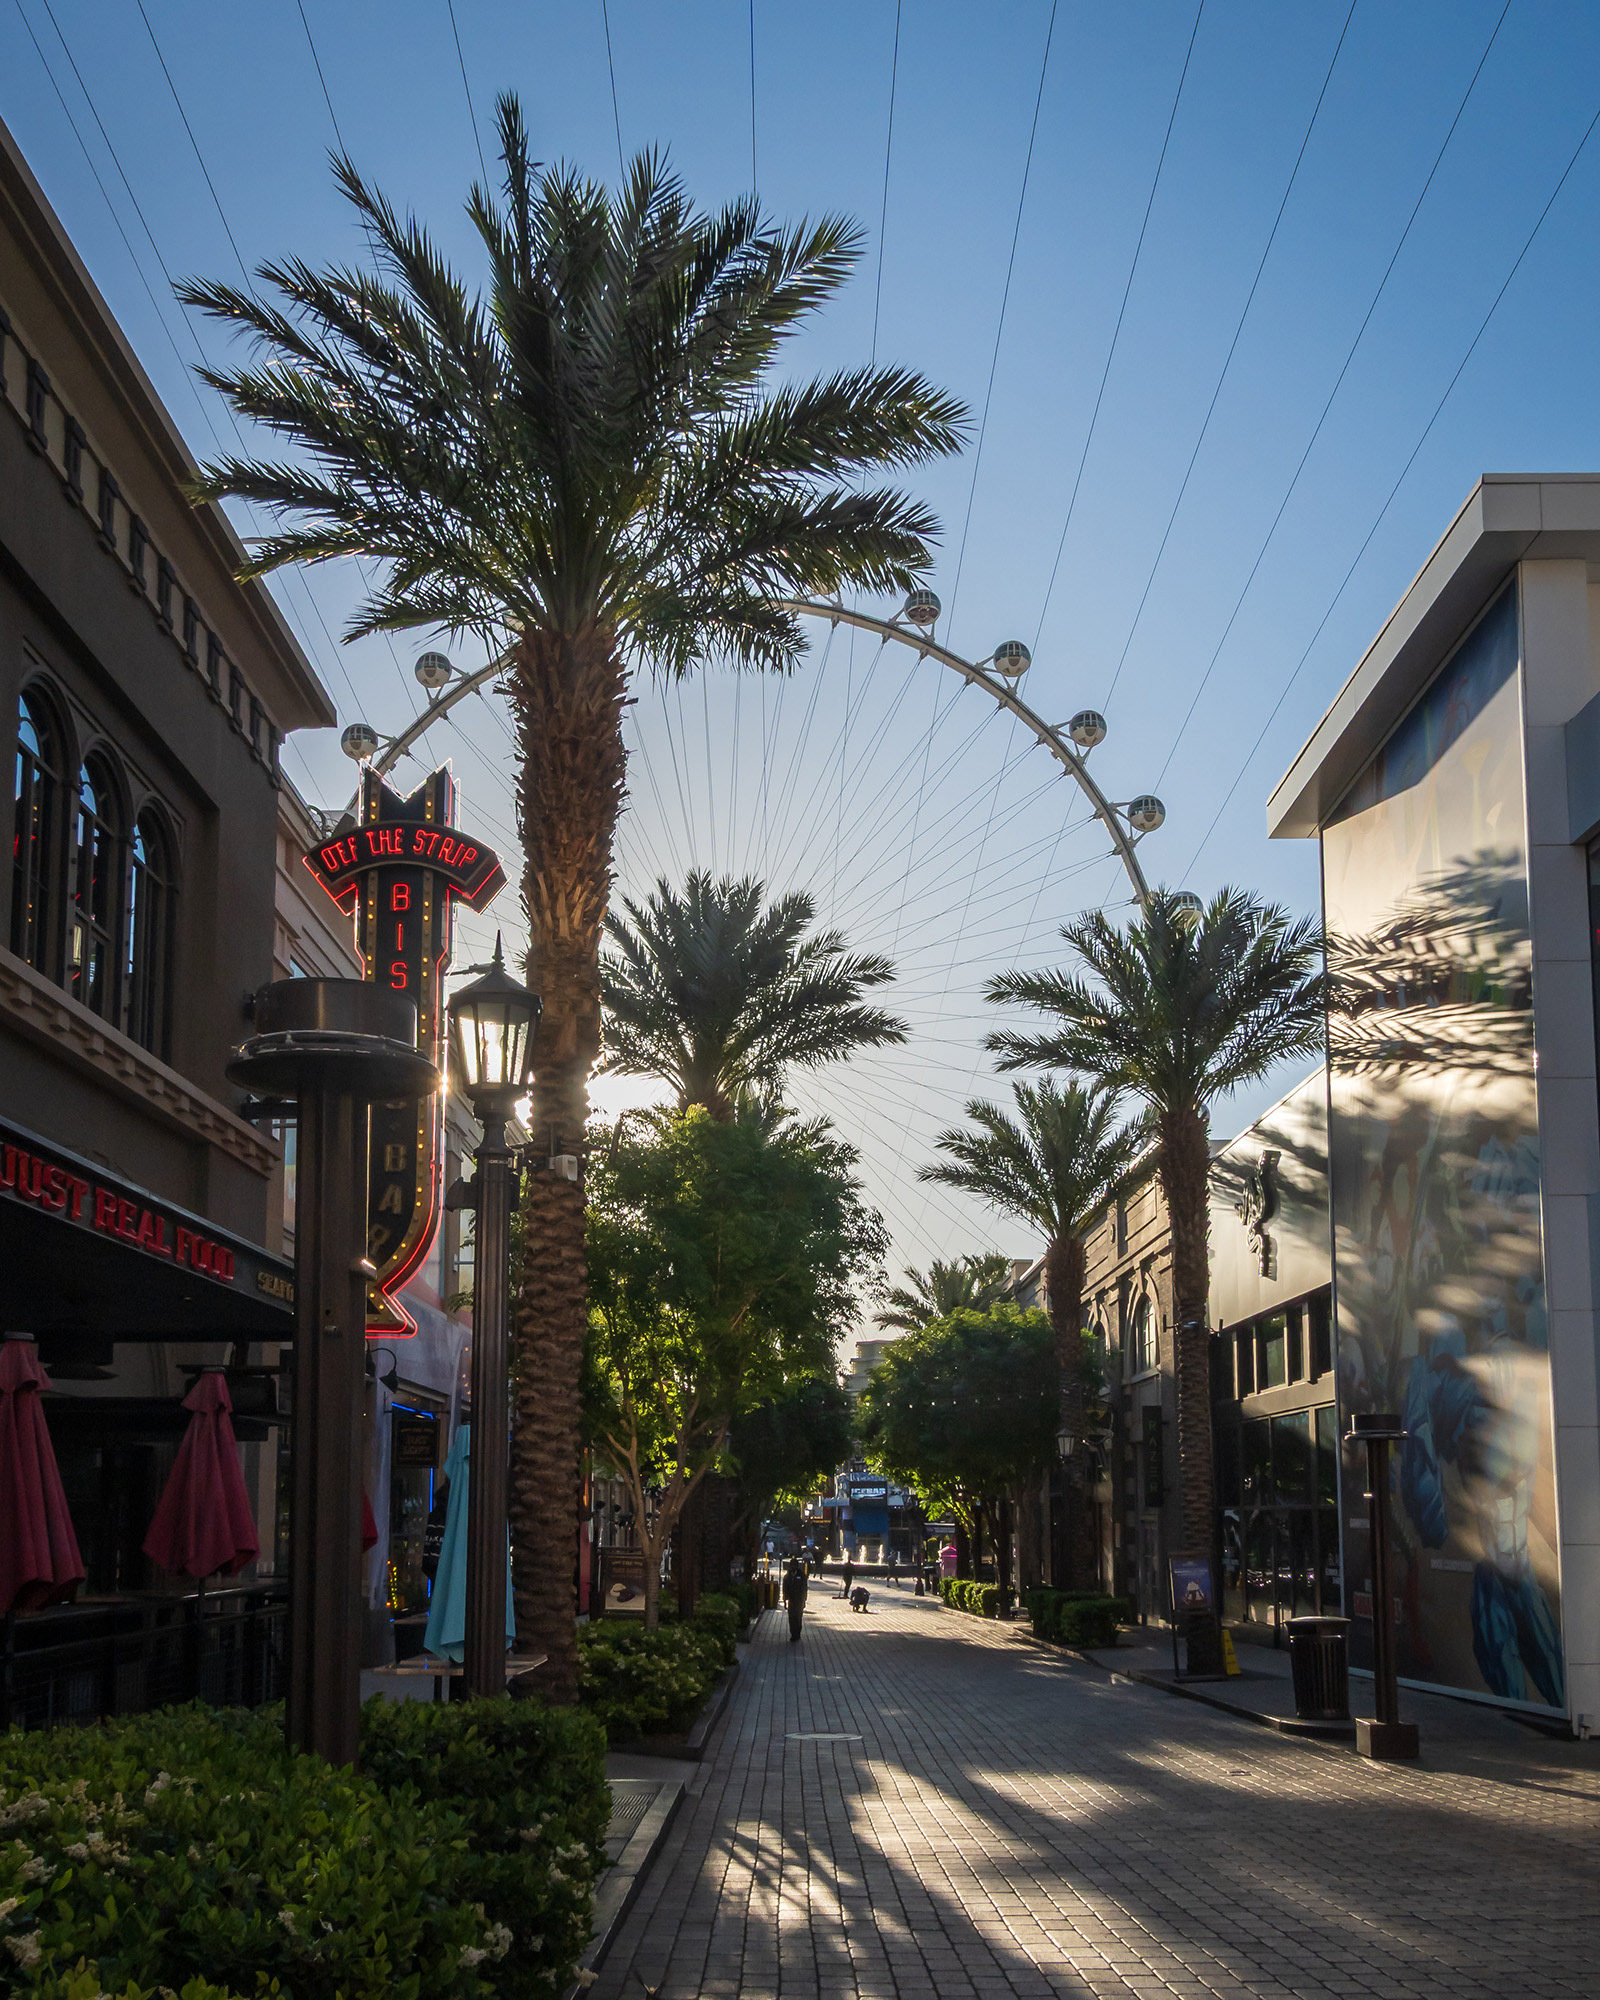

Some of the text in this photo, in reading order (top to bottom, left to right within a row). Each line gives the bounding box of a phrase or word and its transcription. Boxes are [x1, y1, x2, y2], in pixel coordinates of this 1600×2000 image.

[320, 827, 479, 871] OFF THE STRIP
[0, 1143, 235, 1282] JUST REAL FOOD
[369, 1144, 407, 1256] BAR
[1147, 1418, 1159, 1493] RAZER
